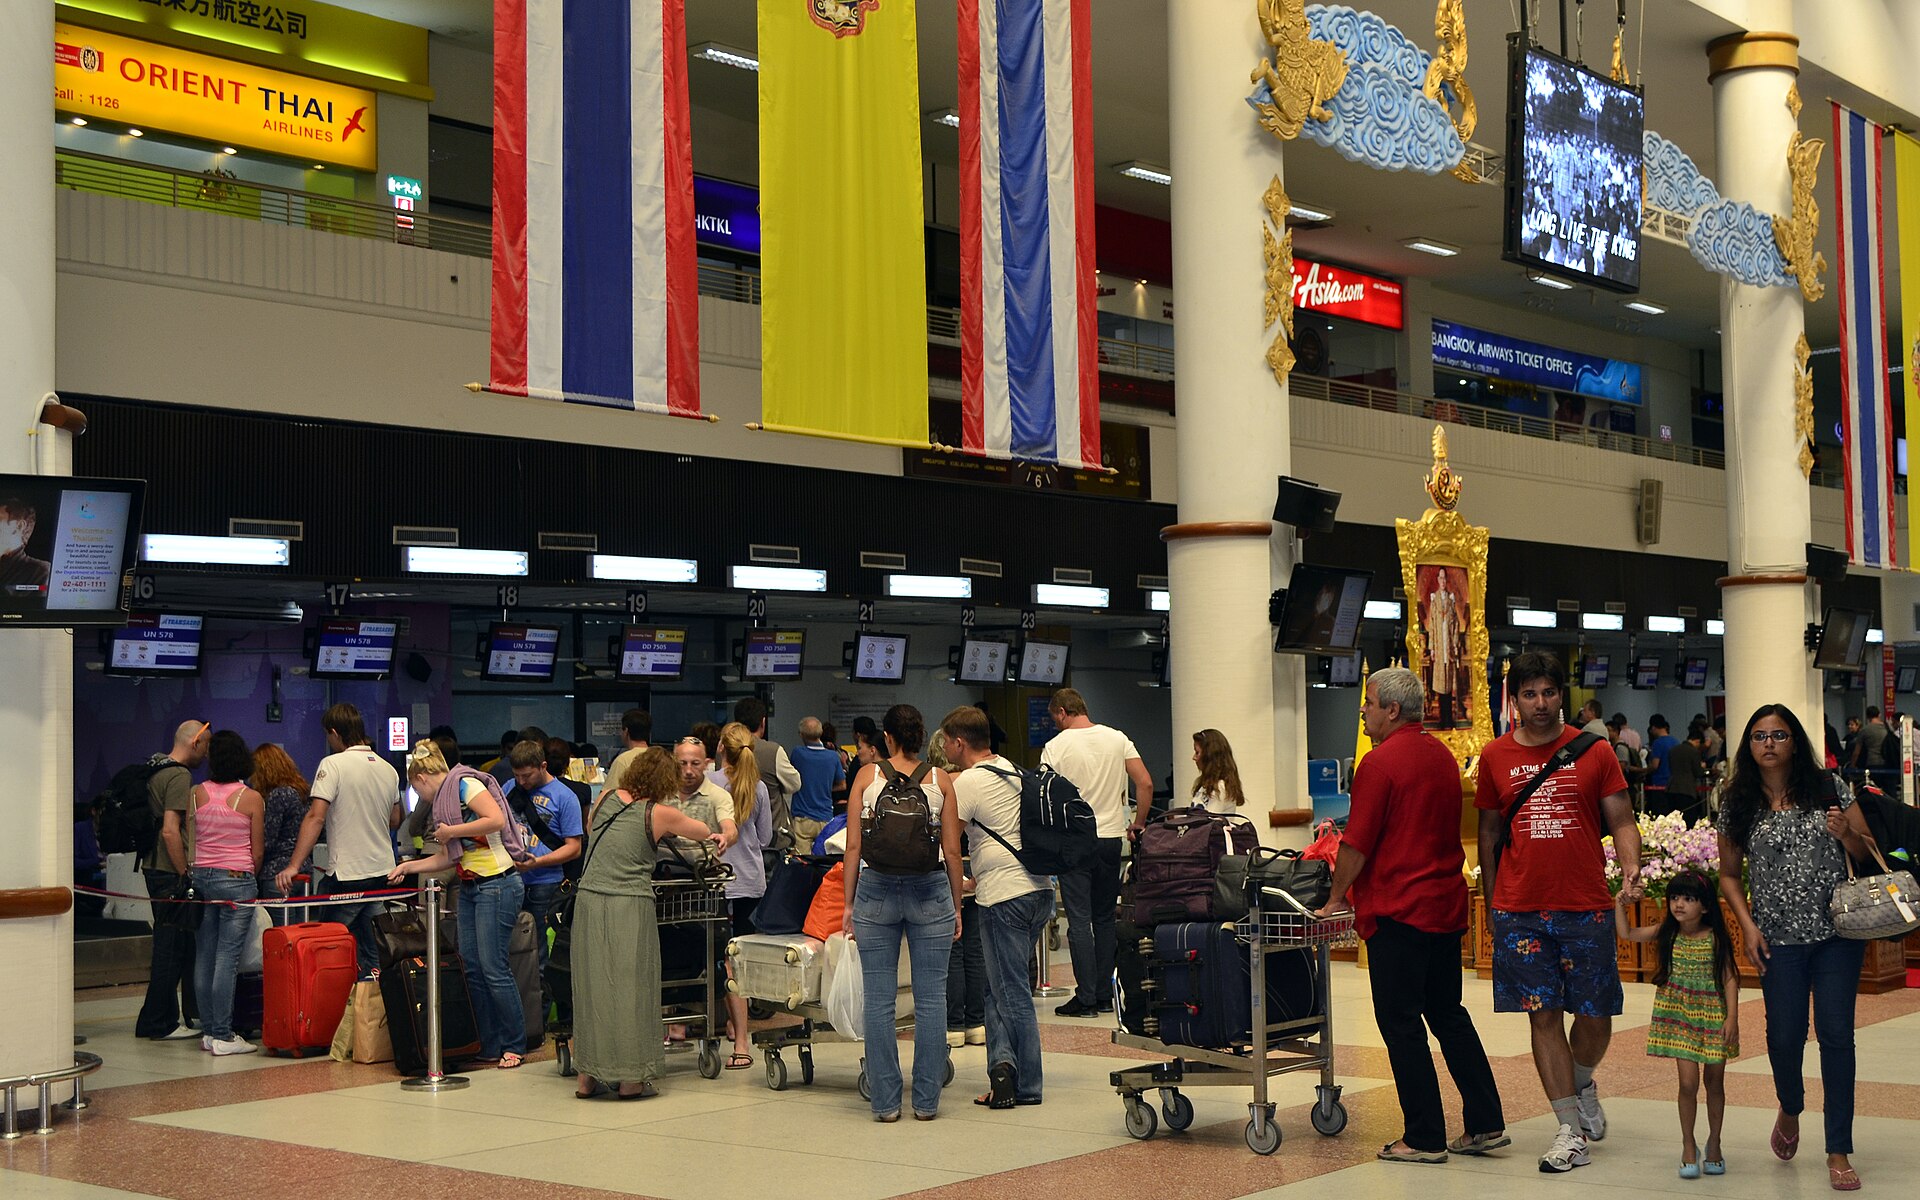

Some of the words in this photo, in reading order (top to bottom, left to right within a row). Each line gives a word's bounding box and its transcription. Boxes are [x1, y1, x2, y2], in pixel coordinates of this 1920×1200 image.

[120, 57, 247, 104] ORIENT
[258, 87, 333, 123] THAI
[90, 94, 119, 109] 1126
[263, 119, 333, 142] AIRLINES
[1530, 208, 1557, 236] LONG
[1560, 216, 1588, 245] LIVE
[1611, 233, 1637, 261] KING
[1290, 262, 1364, 308] rAsia.com
[1432, 332, 1476, 355] BANGKOK
[1477, 343, 1514, 363] AIRWAYS
[1515, 350, 1544, 369] TICKET
[1545, 357, 1573, 375] OFFICE
[1035, 474, 1041, 488] 6
[134, 577, 154, 599] 16
[327, 584, 349, 605] 17
[499, 586, 518, 605] 18
[627, 594, 646, 613] 19
[750, 600, 765, 617] 20
[860, 604, 874, 621] 21
[962, 610, 975, 626] 22
[1022, 612, 1035, 629] 23
[1510, 767, 1520, 776] MY
[1521, 765, 1539, 773] TIME
